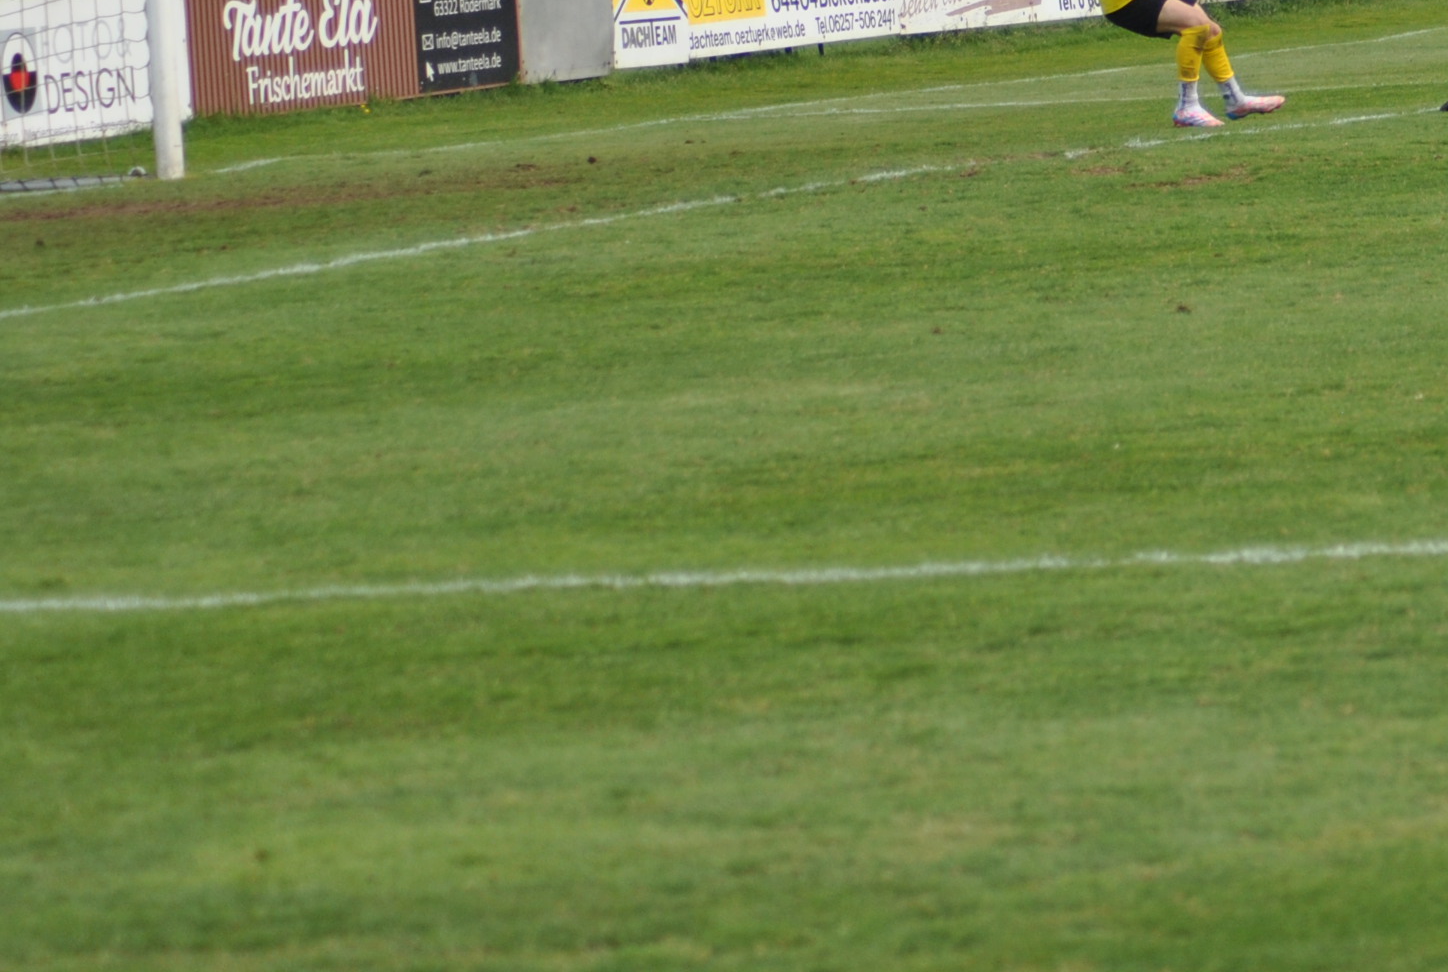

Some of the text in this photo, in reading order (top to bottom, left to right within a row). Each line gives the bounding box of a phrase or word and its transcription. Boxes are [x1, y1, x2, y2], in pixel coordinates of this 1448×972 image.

[436, 26, 502, 50] info@tanteela.de
[246, 48, 365, 105] Frischemarkt
[437, 51, 502, 74] www.tanteela.de
[44, 65, 136, 115] DESIGN
